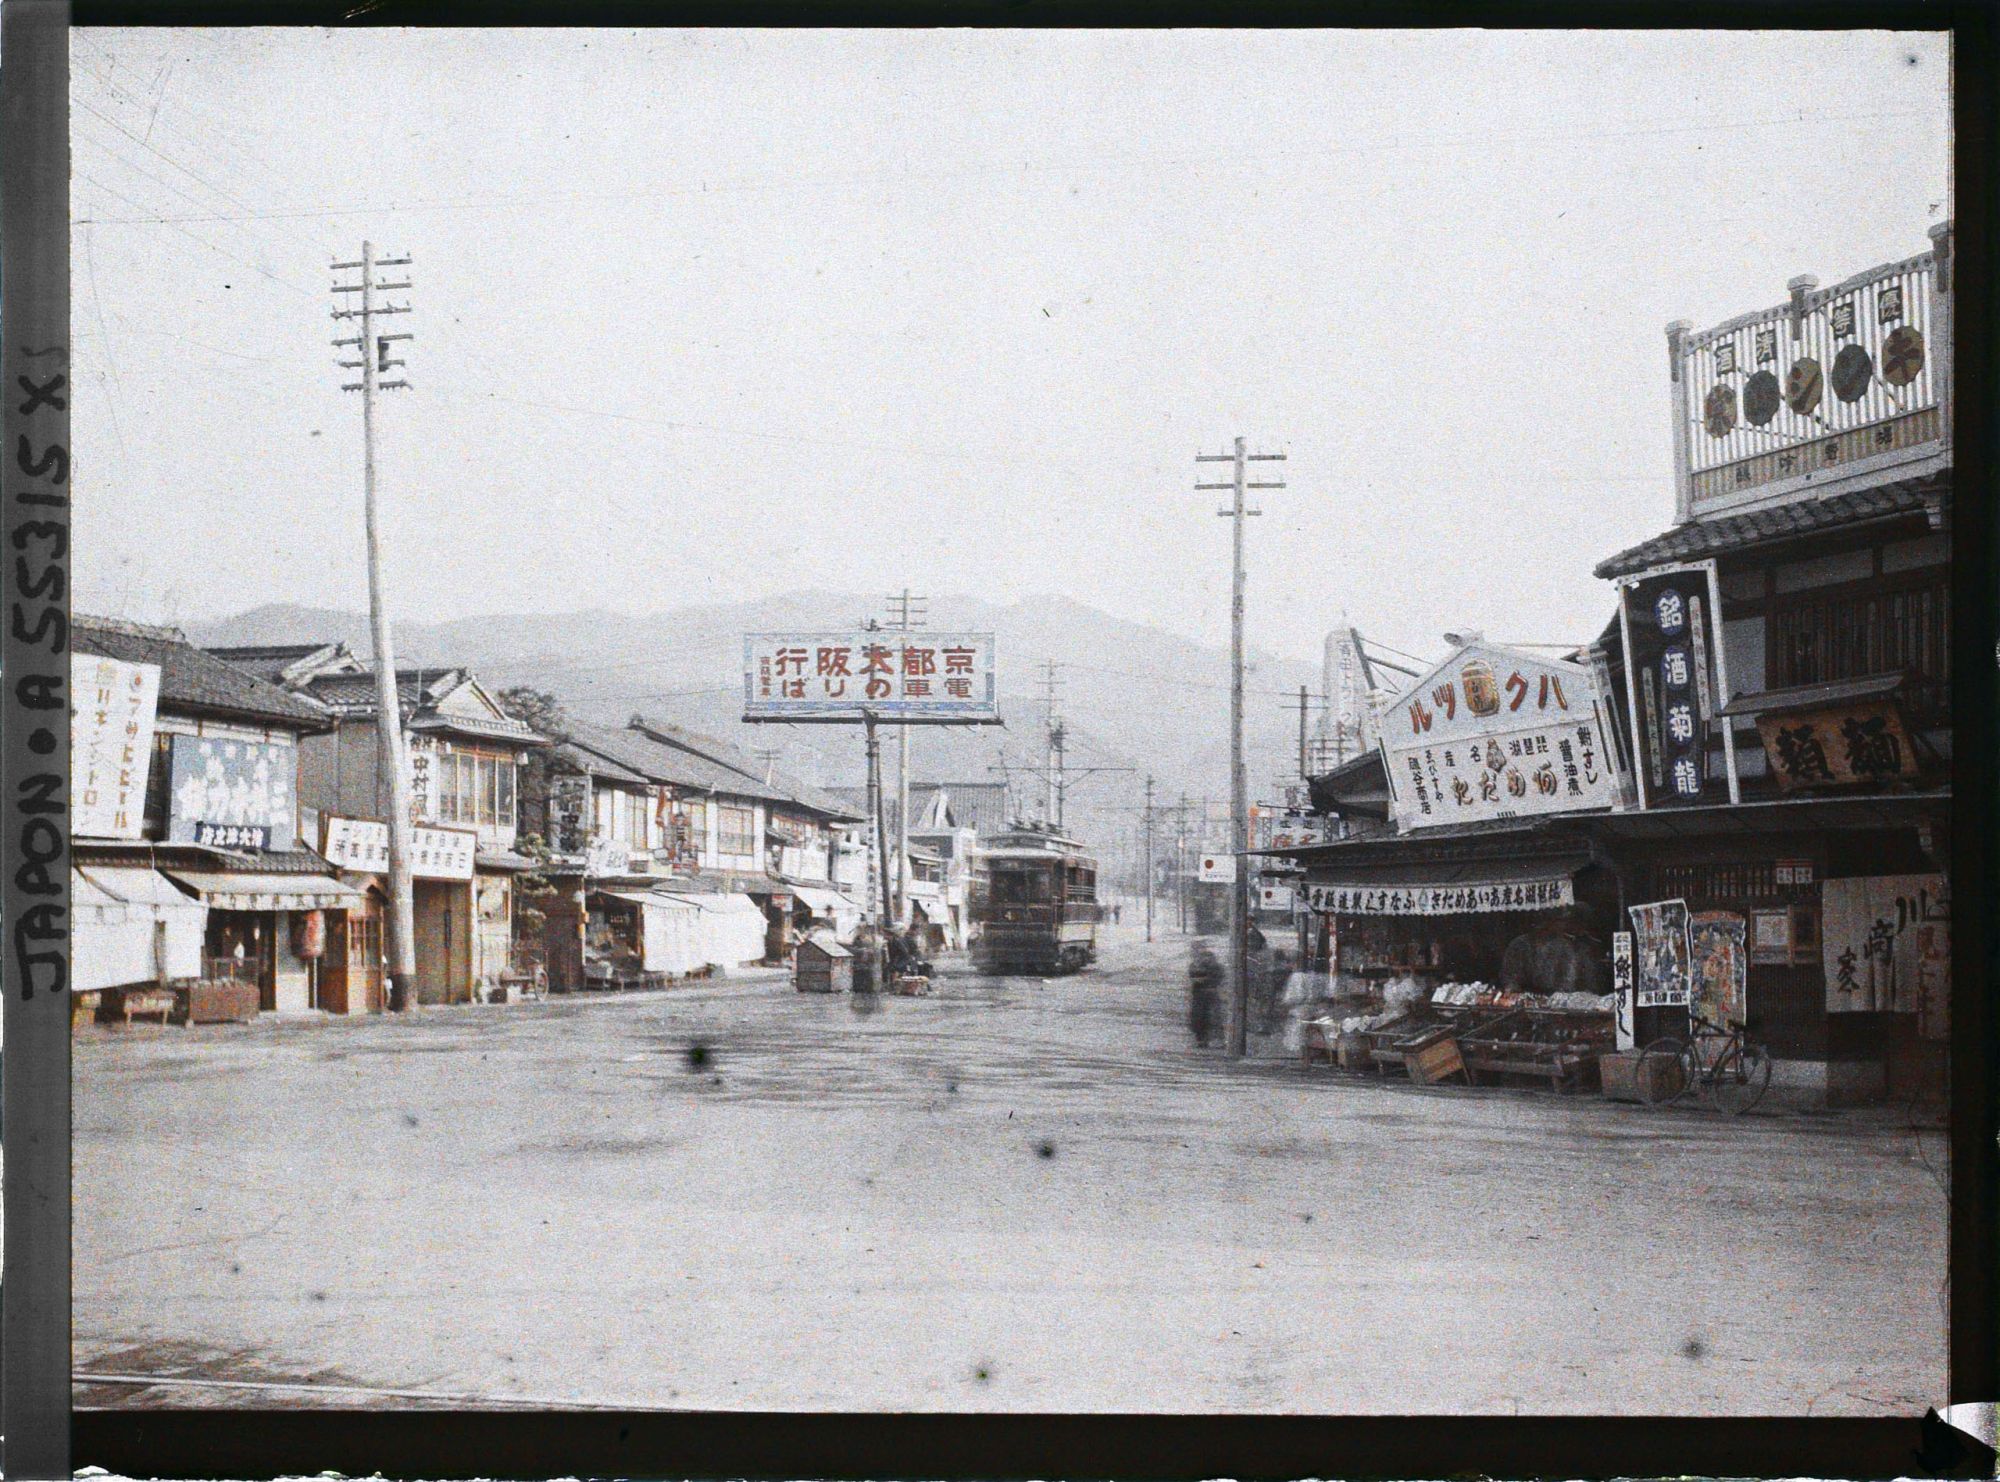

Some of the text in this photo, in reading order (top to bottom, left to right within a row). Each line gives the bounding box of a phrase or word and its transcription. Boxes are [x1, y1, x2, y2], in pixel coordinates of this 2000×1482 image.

[775, 644, 976, 677] 京都大阪行
[782, 678, 973, 699] 電車のりば
